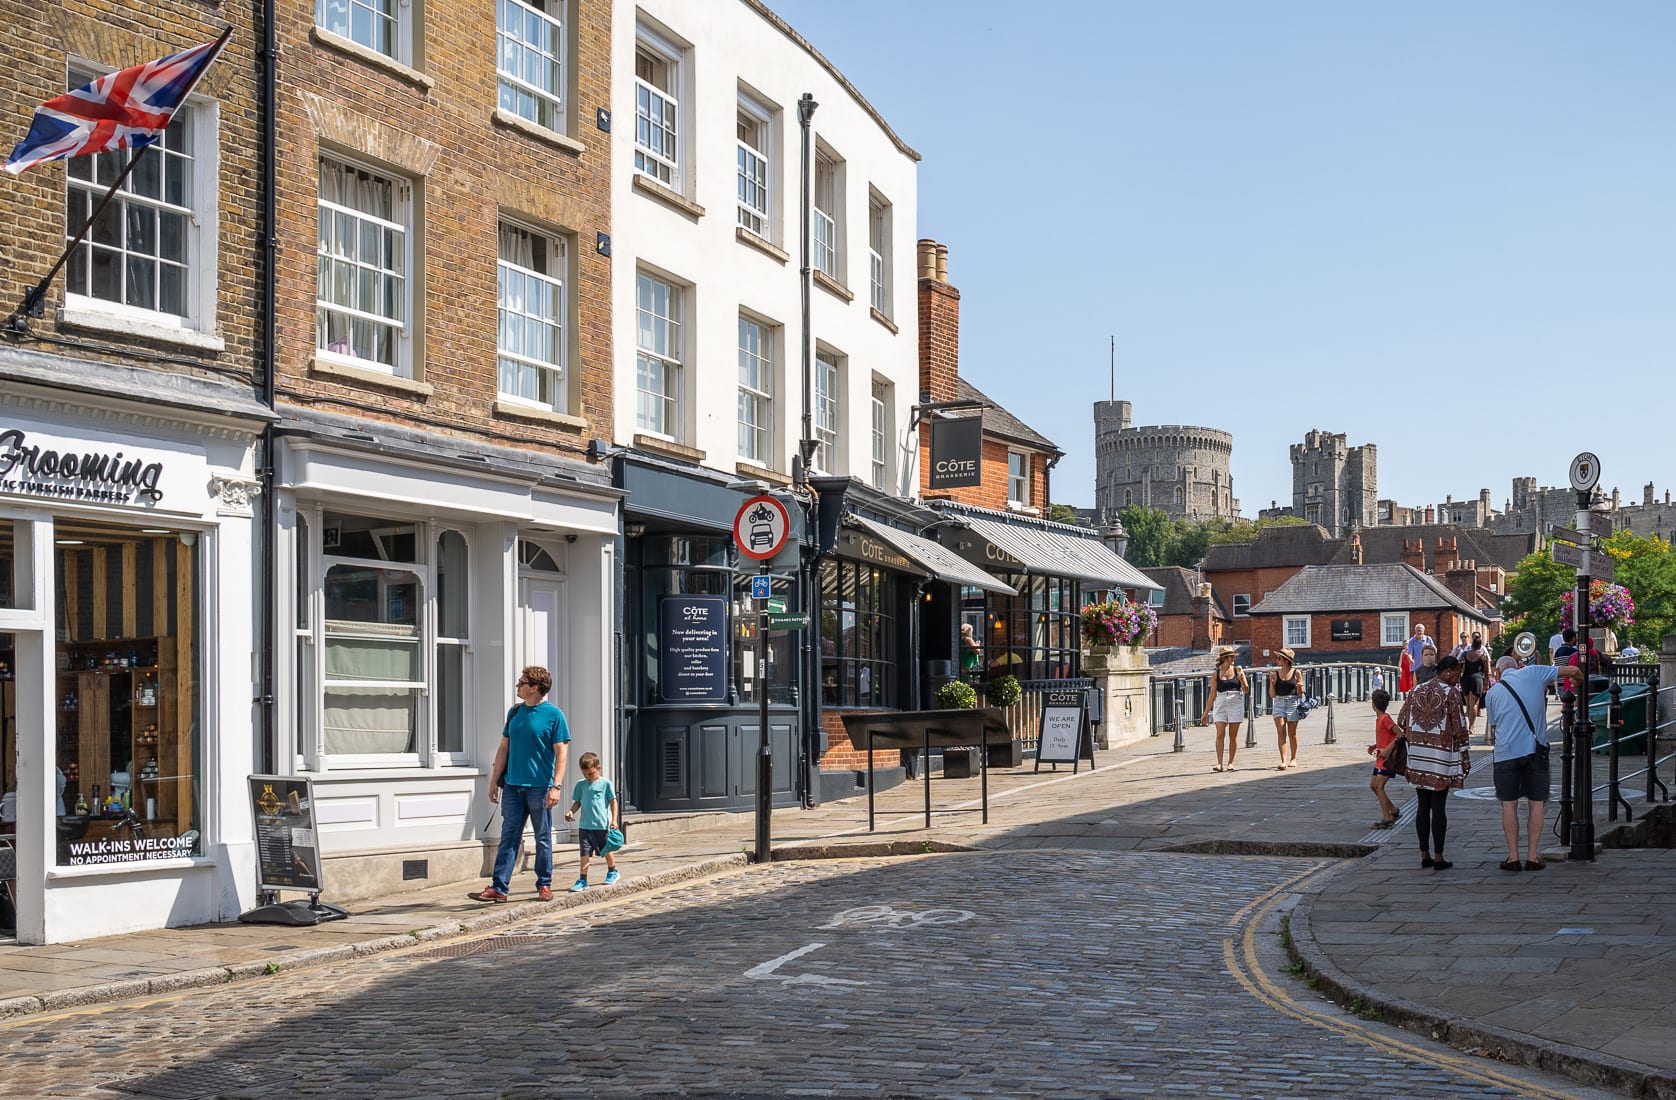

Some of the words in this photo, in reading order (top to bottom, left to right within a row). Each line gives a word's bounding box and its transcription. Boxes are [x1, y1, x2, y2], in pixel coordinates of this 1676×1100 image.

[0, 430, 163, 501] Grooming
[936, 459, 976, 473] CÔTE
[19, 481, 75, 495] TURKISH
[77, 487, 130, 501] BARBERS
[861, 539, 884, 561] CÔTE
[682, 606, 709, 615] CÔTE
[685, 629, 712, 637] delivering
[1050, 693, 1078, 701] CÔTE
[70, 841, 131, 856] WALK-INS
[133, 836, 193, 851] WELCOME
[70, 857, 84, 866] NO
[86, 852, 145, 865] APPOINTMENT
[146, 849, 193, 860] NECESSARY
